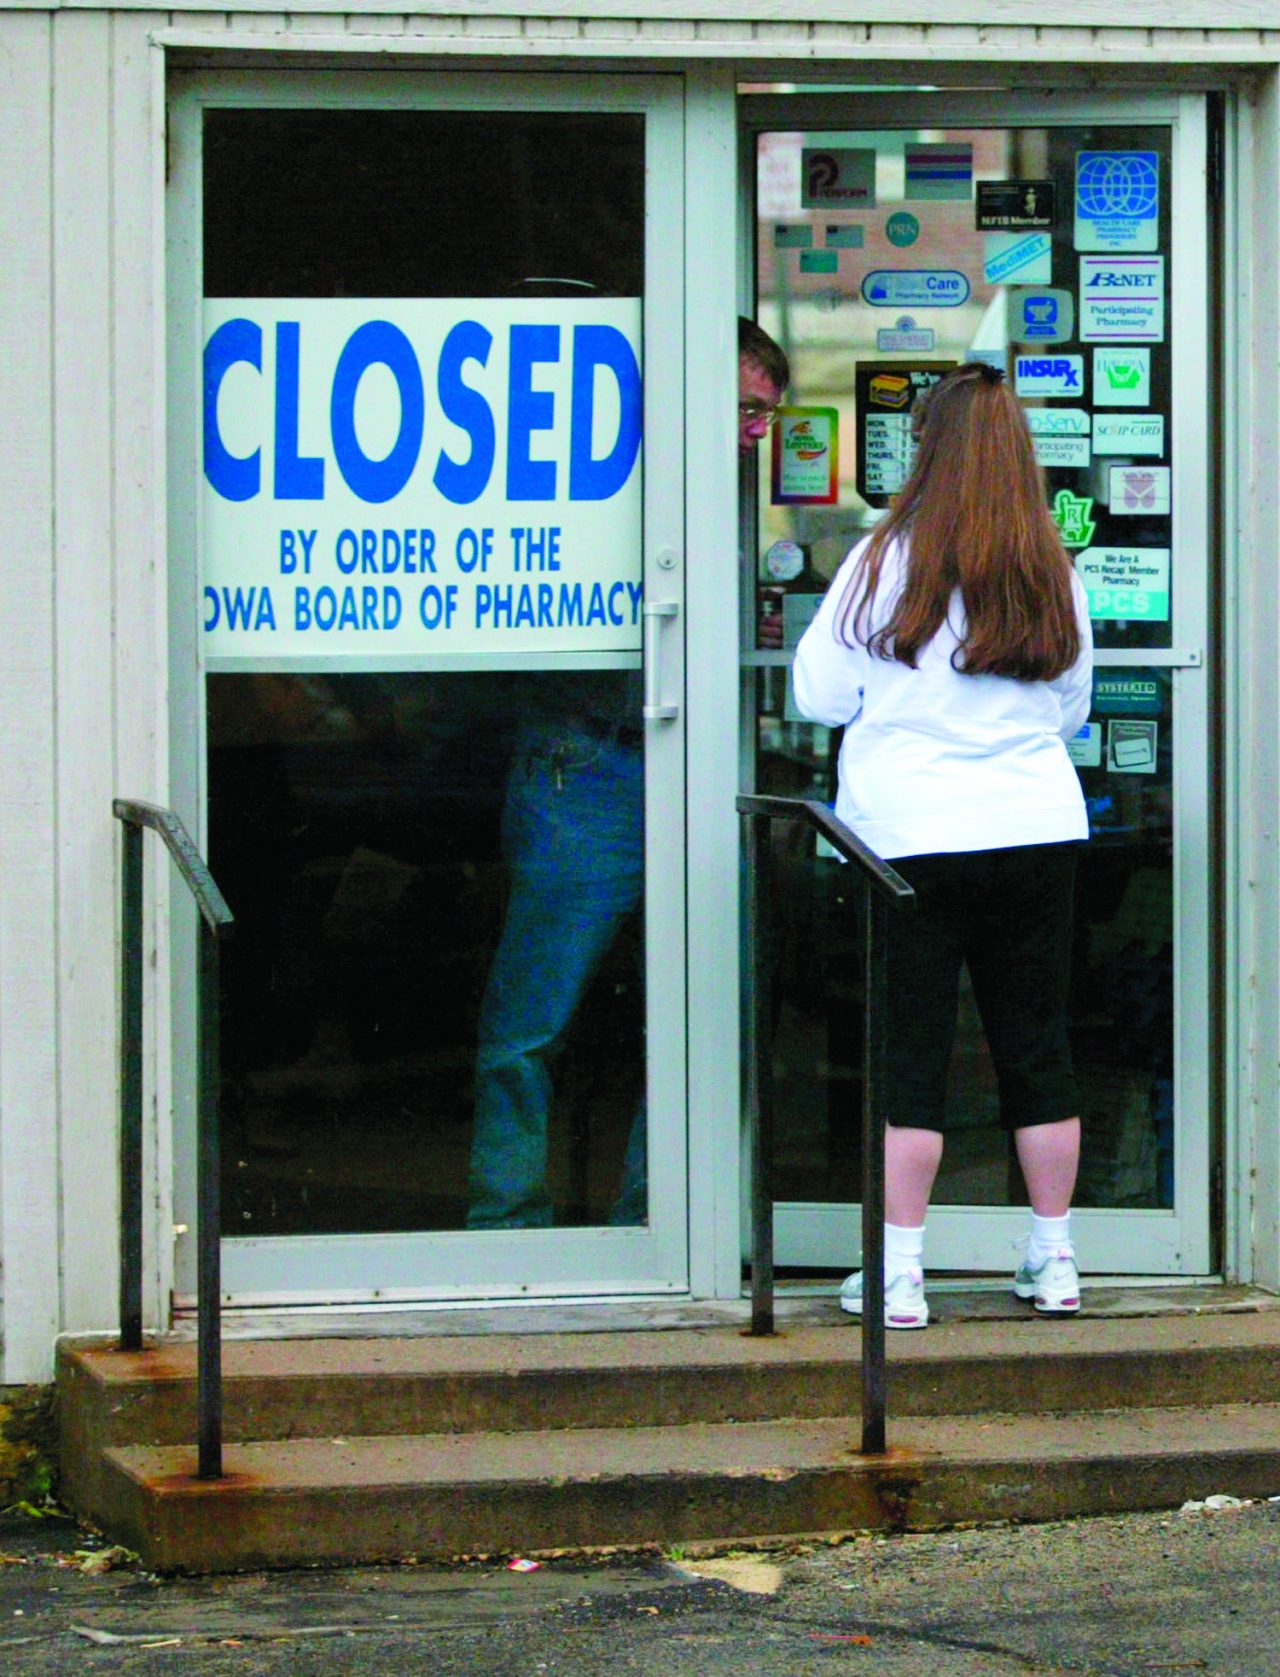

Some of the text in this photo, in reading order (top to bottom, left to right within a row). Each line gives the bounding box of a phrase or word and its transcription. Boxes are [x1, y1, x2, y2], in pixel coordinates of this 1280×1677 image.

[926, 276, 959, 289] Care
[1096, 317, 1147, 328] Pharmacy
[203, 318, 642, 505] CLOSED
[280, 527, 562, 574] BY ORDER OF THE
[1118, 555, 1131, 563] Are
[1133, 555, 1139, 563] A
[1128, 566, 1159, 575] Member
[1102, 576, 1140, 586] Pharmacy
[204, 581, 643, 632] OWA BOARD OF PHARMACY
[1093, 591, 1150, 613] PCS
